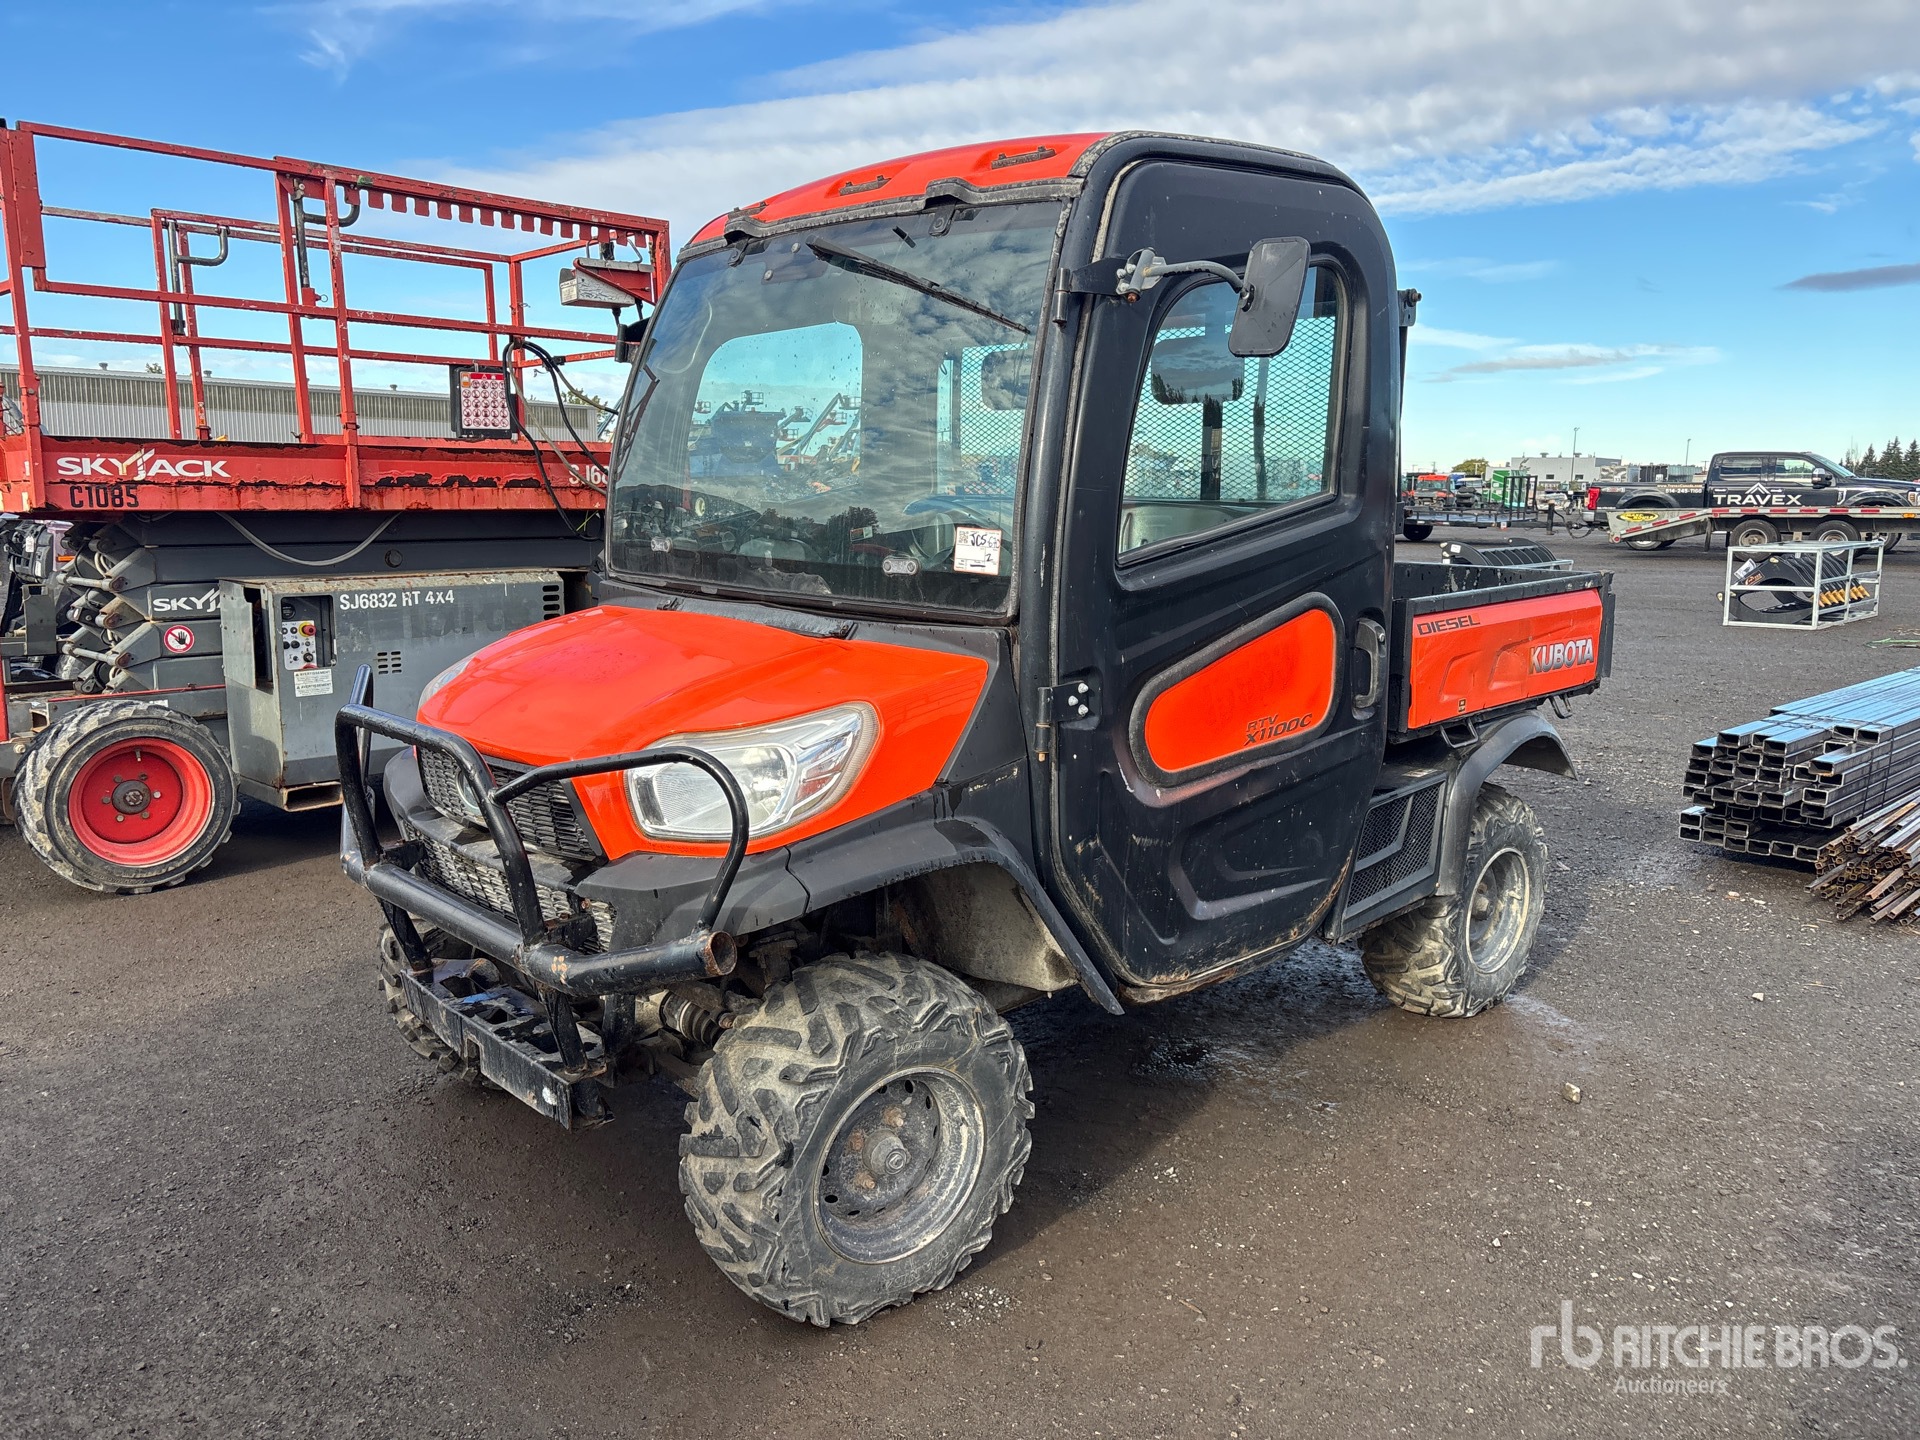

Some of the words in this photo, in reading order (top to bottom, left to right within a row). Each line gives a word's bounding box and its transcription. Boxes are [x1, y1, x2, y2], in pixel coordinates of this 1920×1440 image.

[56, 448, 231, 481] SKYJACK
[69, 484, 140, 508] C1085
[1713, 494, 1802, 506] TRAVEX
[339, 593, 398, 610] SJ6832
[402, 590, 421, 607] RT
[1417, 615, 1481, 636] DIESEL
[1529, 638, 1594, 675] KUBOTA
[1243, 713, 1313, 747] X1100C
[1246, 714, 1278, 732] RTV
